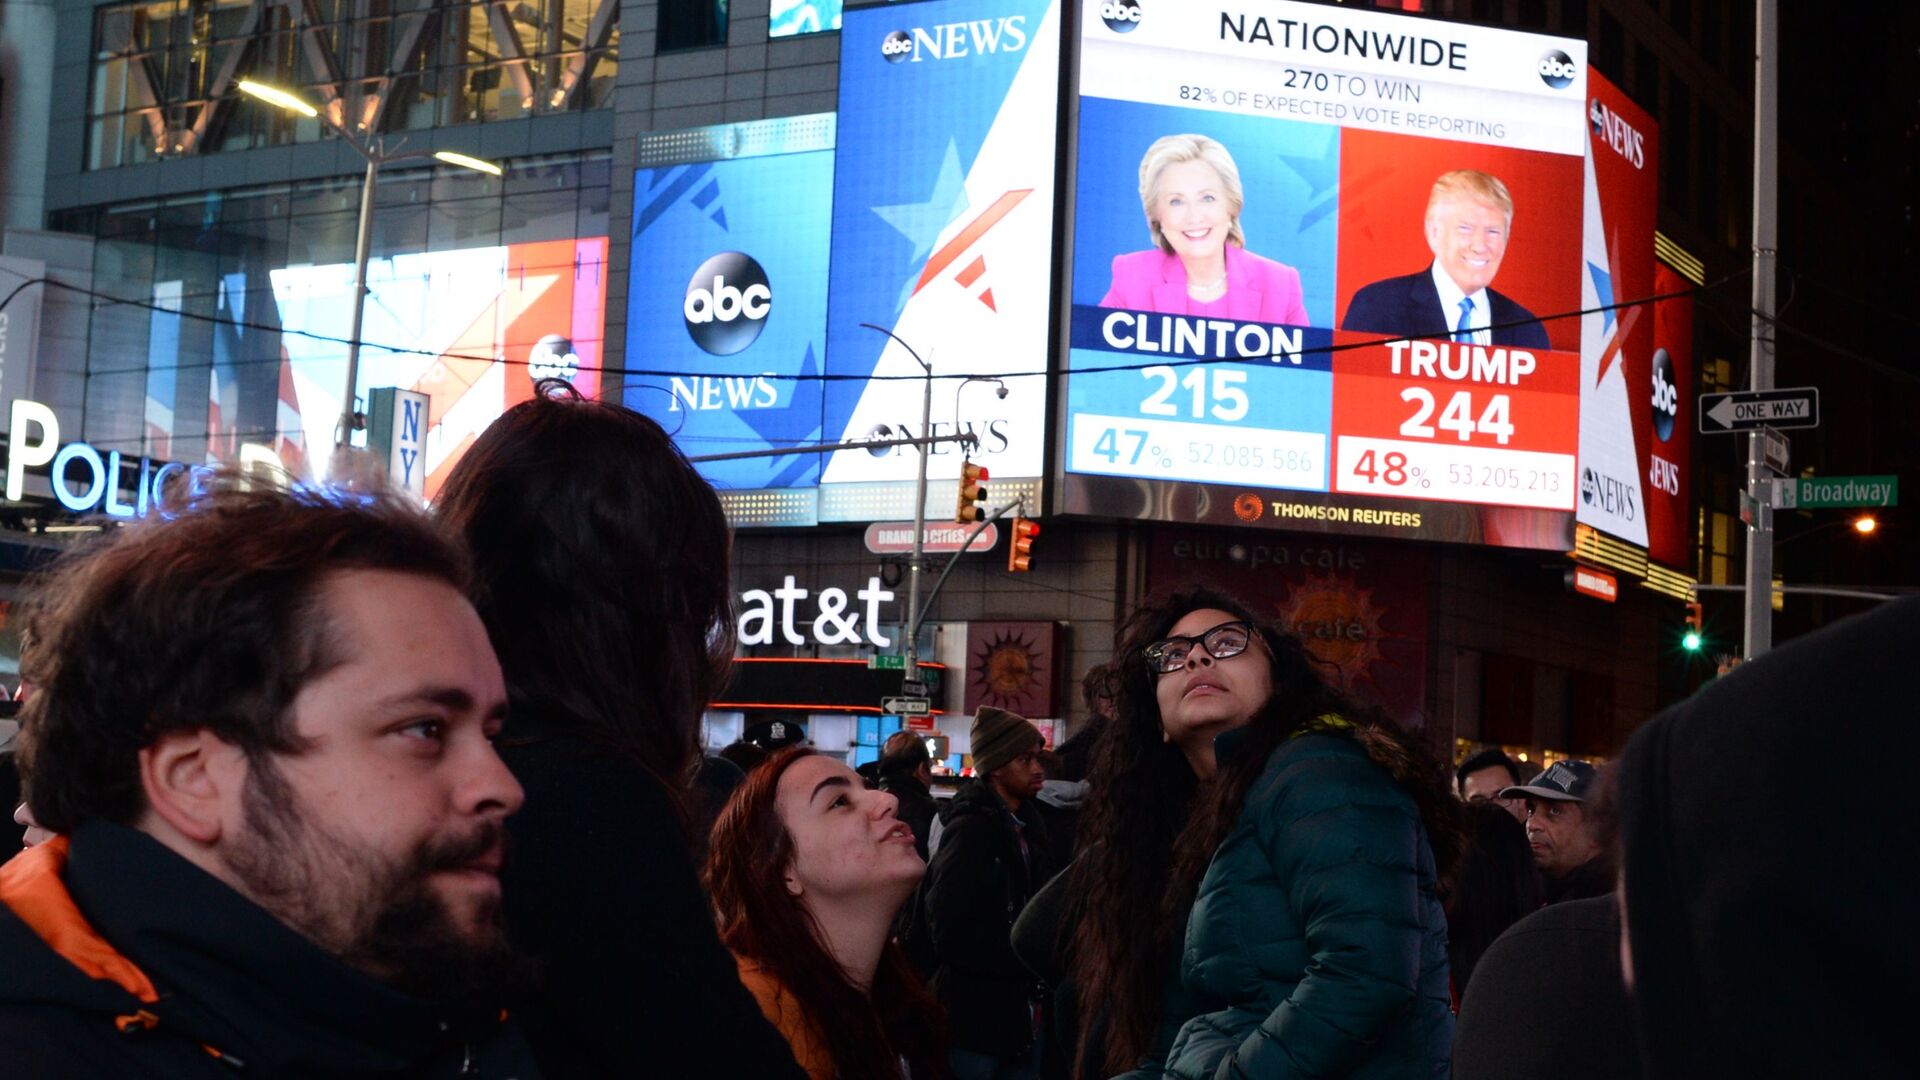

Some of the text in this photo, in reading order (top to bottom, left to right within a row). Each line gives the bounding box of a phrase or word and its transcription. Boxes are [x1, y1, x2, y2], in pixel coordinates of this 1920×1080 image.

[1101, 1, 1141, 22] abc
[882, 15, 1026, 62] abc NEWS
[1220, 11, 1467, 71] NATIONWIDE
[1284, 69, 1421, 103] 270 TO WIN
[1538, 57, 1576, 79] abc
[1179, 85, 1506, 139] 82% OF EXPECTED VOTE REPORTING
[1601, 103, 1644, 169] NEWS
[684, 275, 772, 323] abc
[1102, 311, 1304, 364] CLINTON
[1385, 338, 1537, 385] TRUMP
[669, 372, 778, 411] NEWS
[1140, 365, 1250, 421] 215
[1735, 401, 1804, 419] ONE WAY
[1400, 386, 1514, 445] 244
[896, 419, 1009, 457] NEWS
[1093, 427, 1172, 469] 47%
[1353, 449, 1431, 489] 48%
[1272, 502, 1422, 528] THOMSON REUTERS
[1593, 471, 1635, 522] NEWS
[1802, 481, 1891, 506] Broadway
[878, 530, 927, 544] BRANDD
[737, 575, 895, 648] at&t
